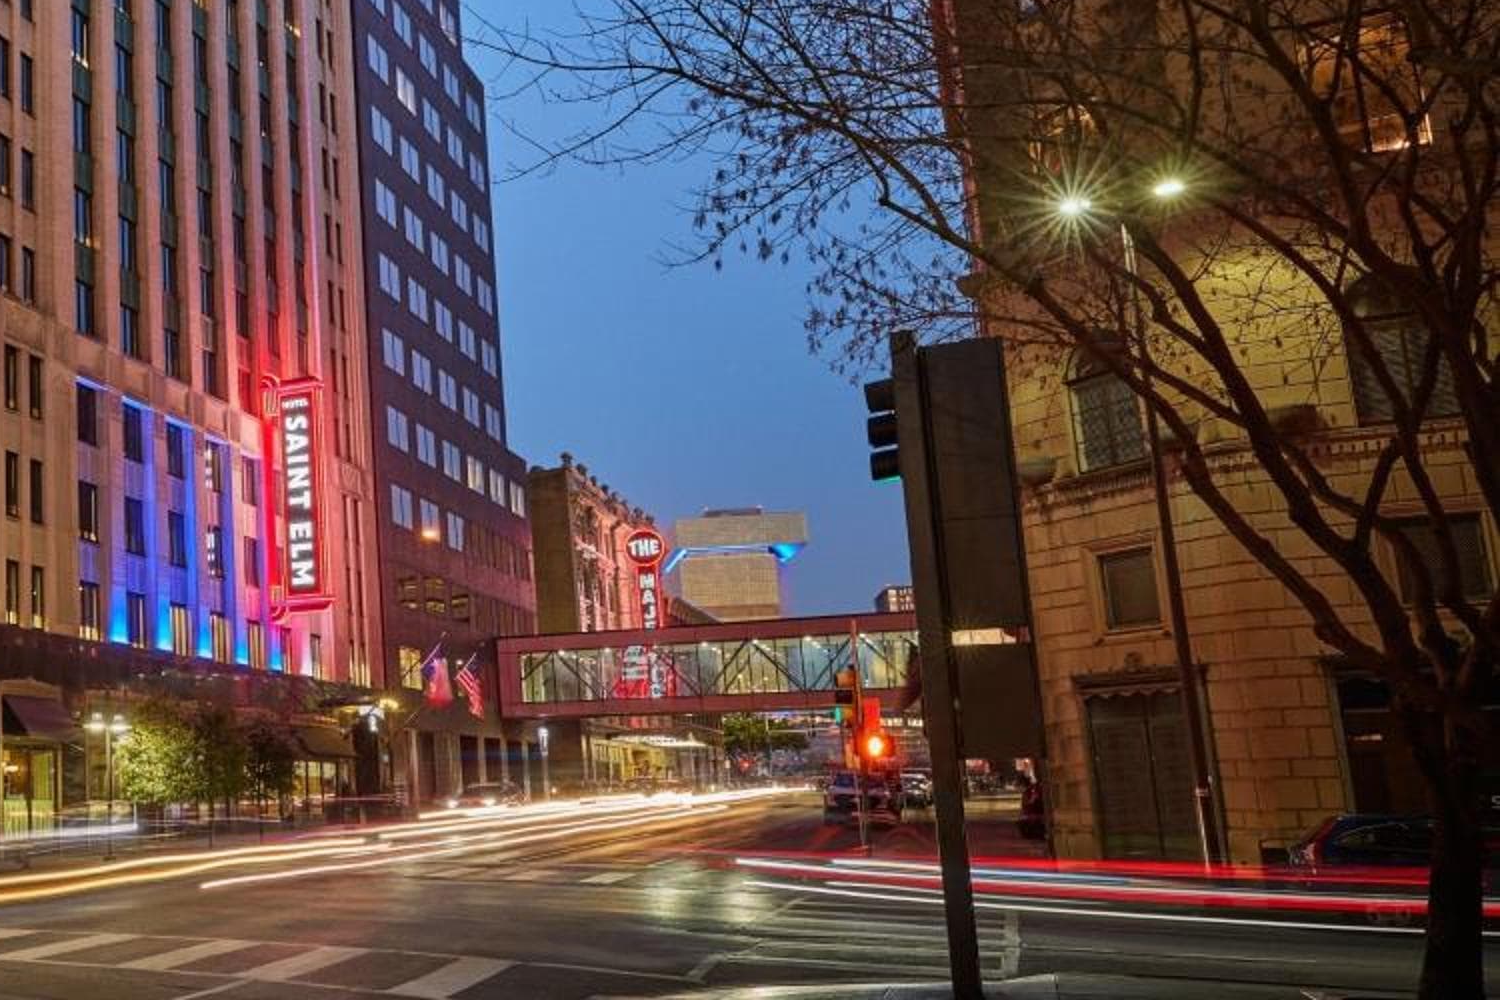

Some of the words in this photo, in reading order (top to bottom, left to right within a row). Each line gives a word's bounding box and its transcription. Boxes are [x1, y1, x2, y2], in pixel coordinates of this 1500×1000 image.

[285, 415, 311, 510] SAINT
[289, 521, 316, 587] ELM
[628, 539, 660, 556] THE
